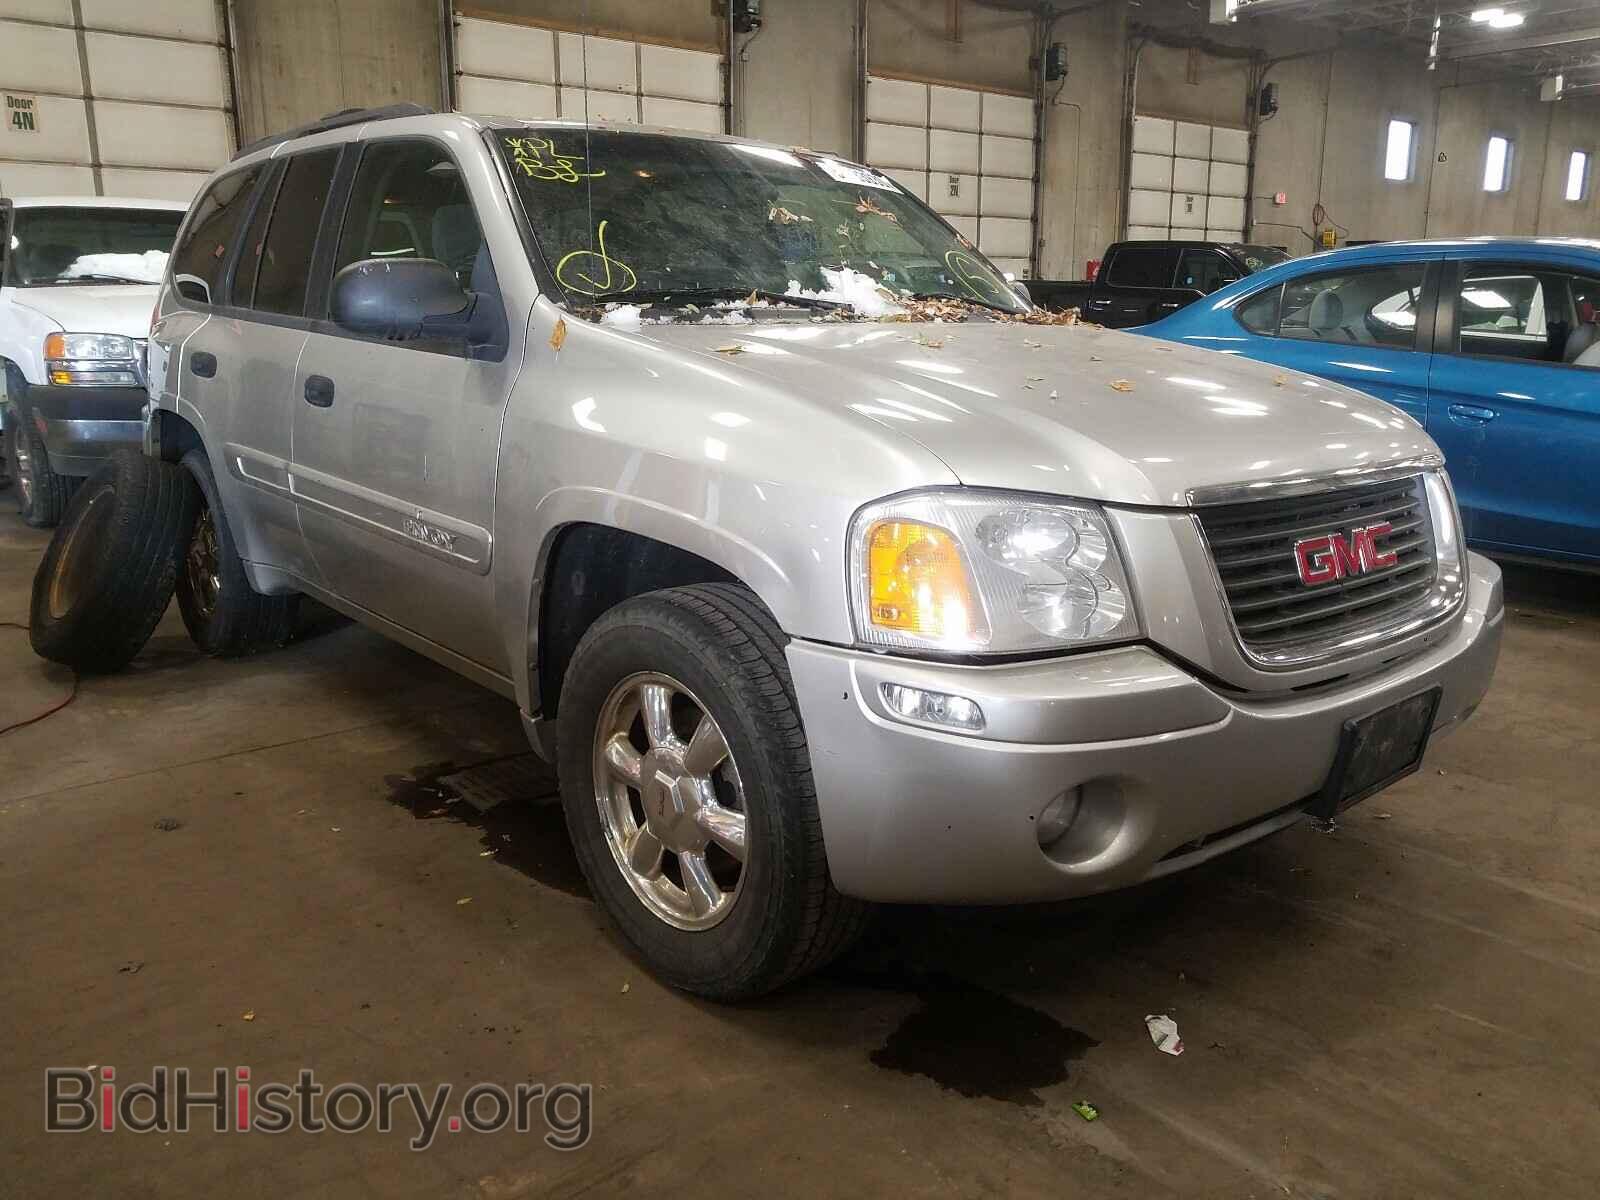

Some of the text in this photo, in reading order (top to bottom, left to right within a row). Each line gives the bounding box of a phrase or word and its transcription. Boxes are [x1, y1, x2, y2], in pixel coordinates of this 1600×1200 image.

[7, 95, 33, 109] Door
[12, 111, 35, 130] 4N
[1294, 521, 1397, 586] GMC
